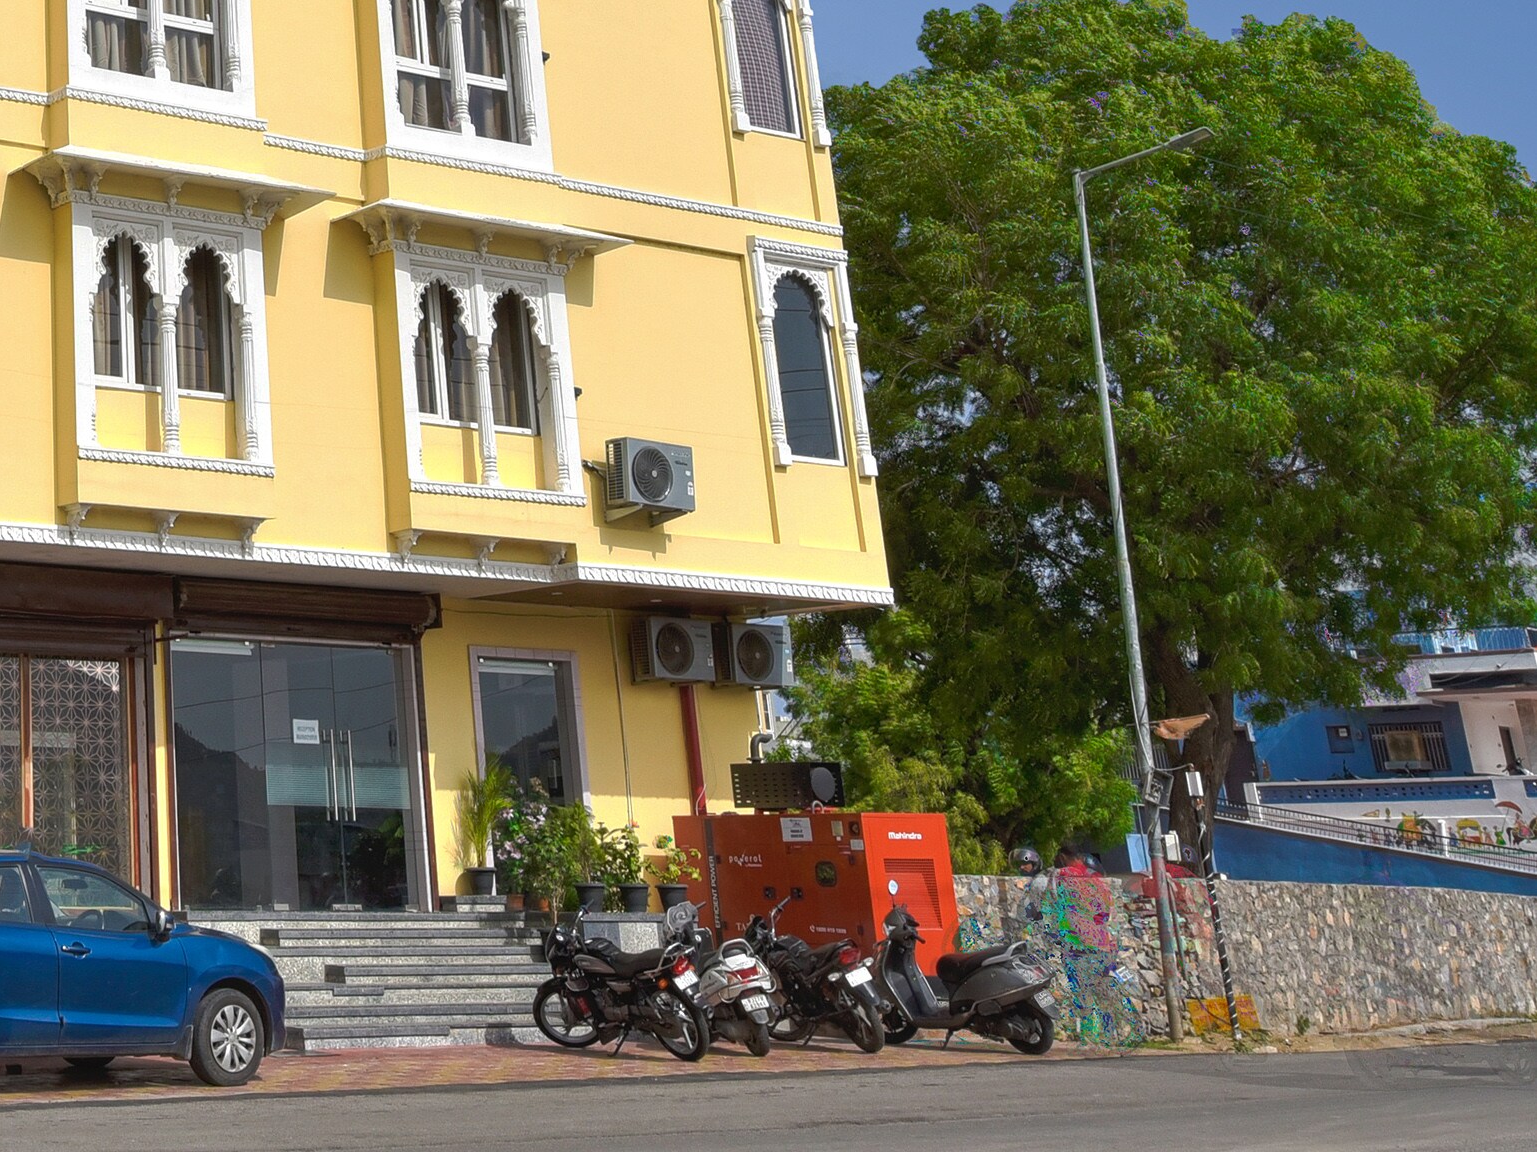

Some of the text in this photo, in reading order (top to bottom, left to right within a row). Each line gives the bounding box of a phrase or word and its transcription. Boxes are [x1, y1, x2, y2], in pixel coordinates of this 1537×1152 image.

[888, 831, 922, 840] Mahindra
[708, 855, 721, 928] EFFICIENT POWER
